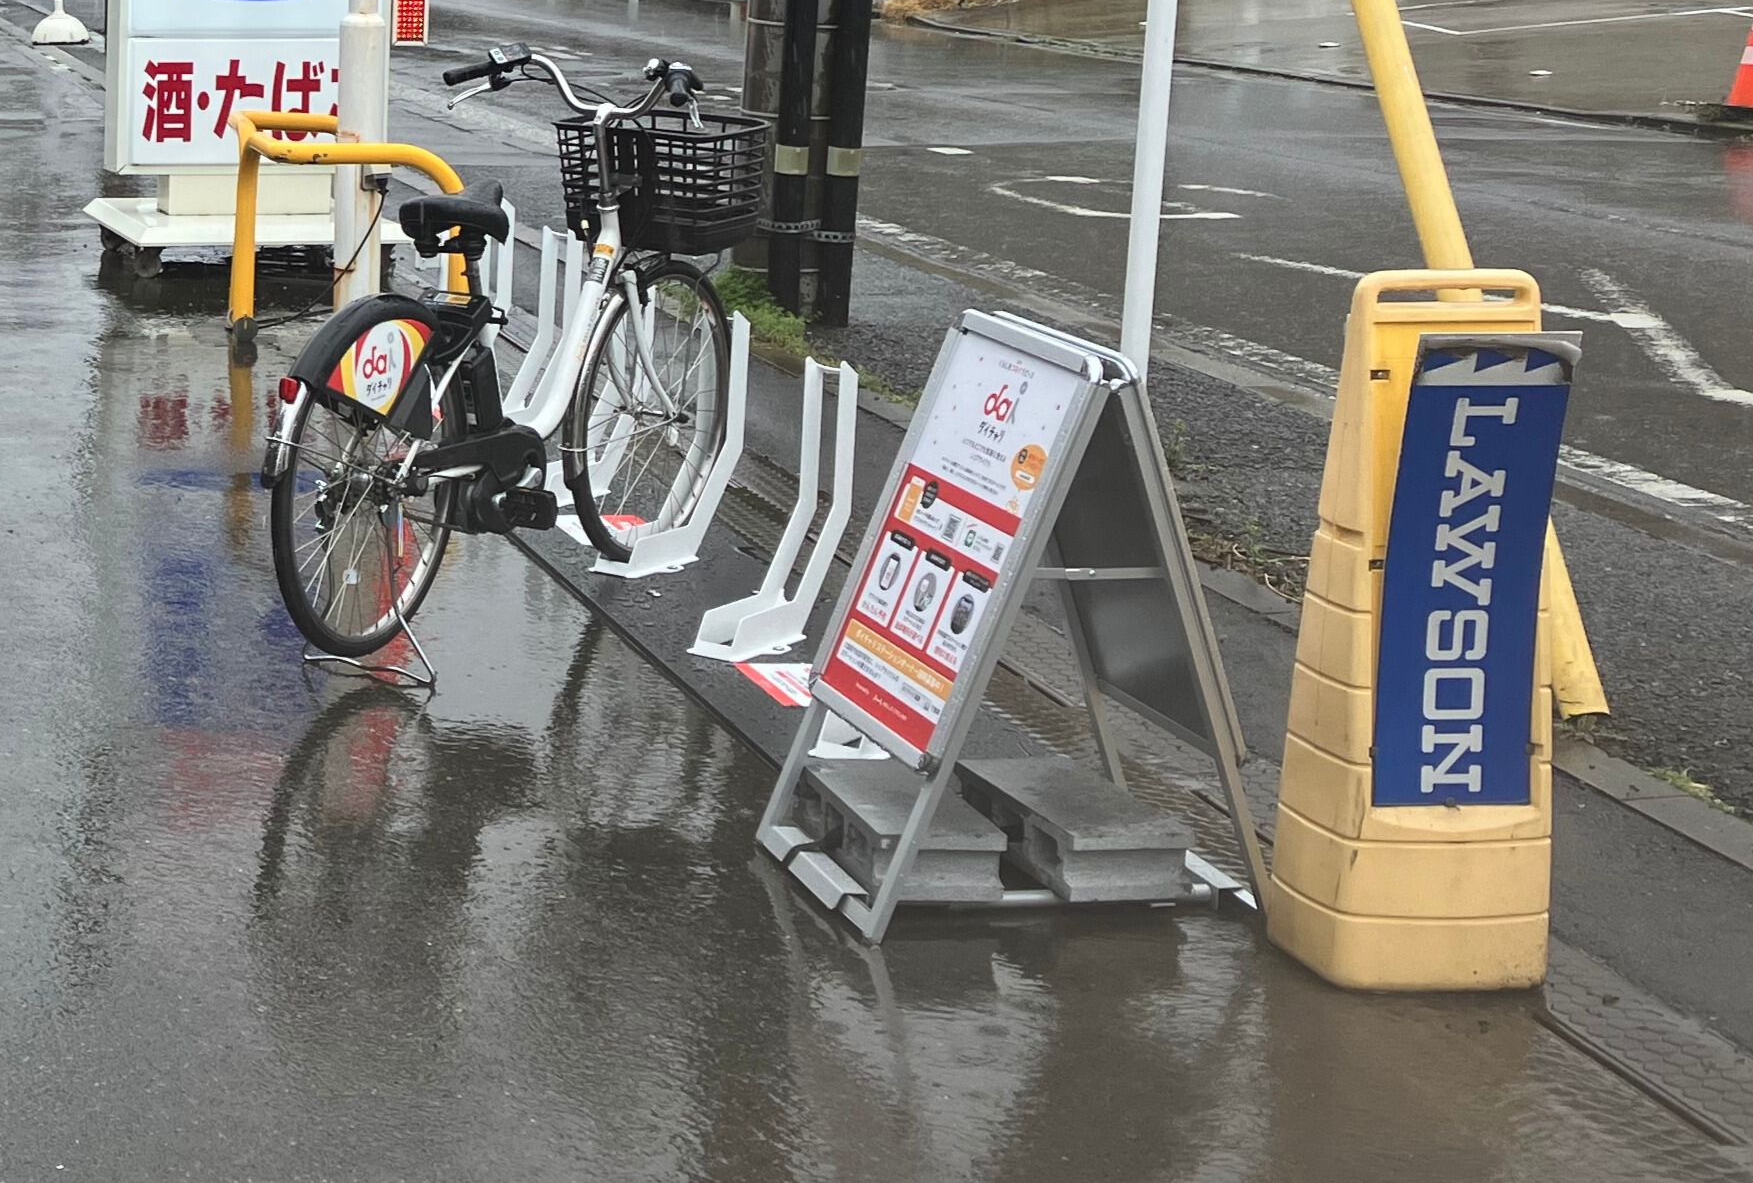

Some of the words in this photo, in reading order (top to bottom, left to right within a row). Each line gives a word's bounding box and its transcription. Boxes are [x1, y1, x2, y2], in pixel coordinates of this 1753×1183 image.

[142, 58, 340, 143] 酒・たば
[362, 331, 397, 380] dai
[365, 377, 393, 397] ダイチャリ
[983, 380, 1029, 425] dai
[977, 421, 1006, 443] ダイチャリ
[1420, 396, 1518, 795] LAWSON
